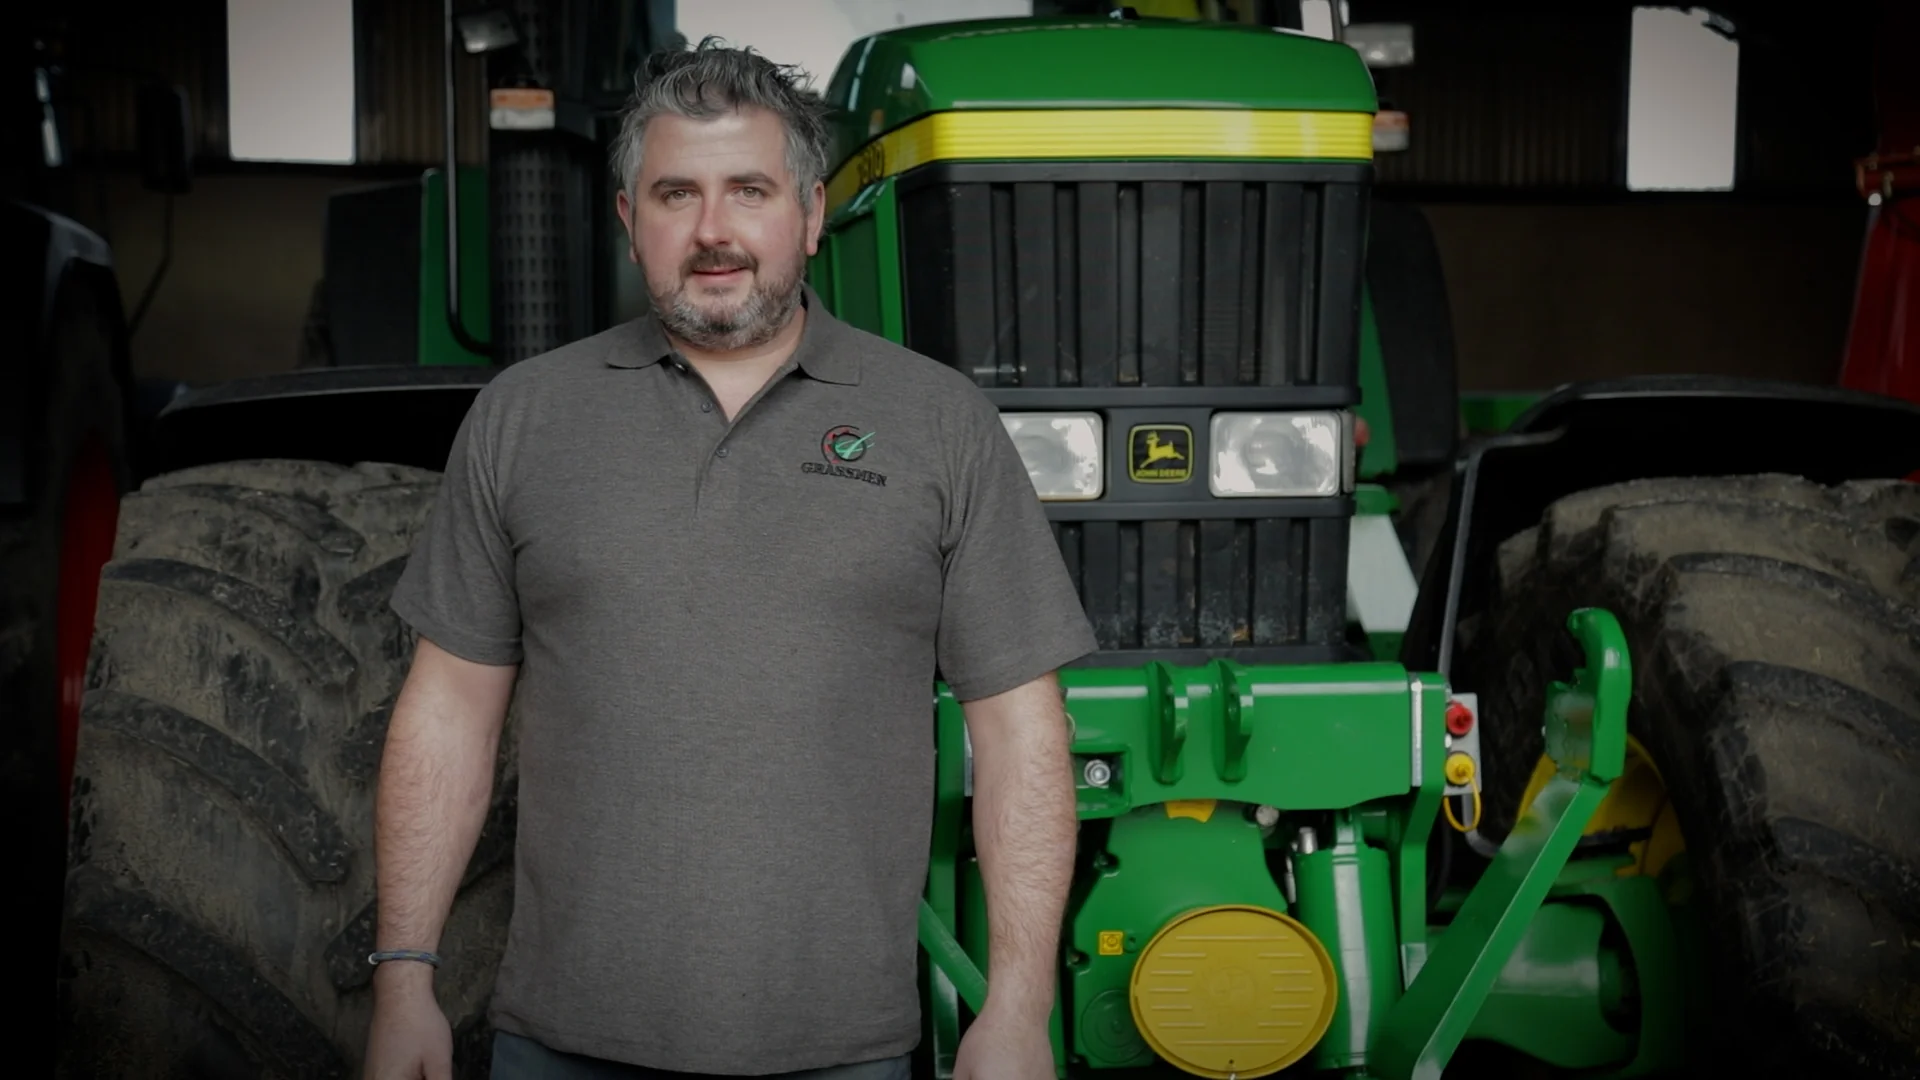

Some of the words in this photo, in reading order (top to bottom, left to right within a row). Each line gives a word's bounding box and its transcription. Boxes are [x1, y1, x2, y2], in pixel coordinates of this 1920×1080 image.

[801, 462, 887, 486] GRASSMEN
[1136, 468, 1157, 479] JOHN
[1159, 468, 1187, 479] DEERE
